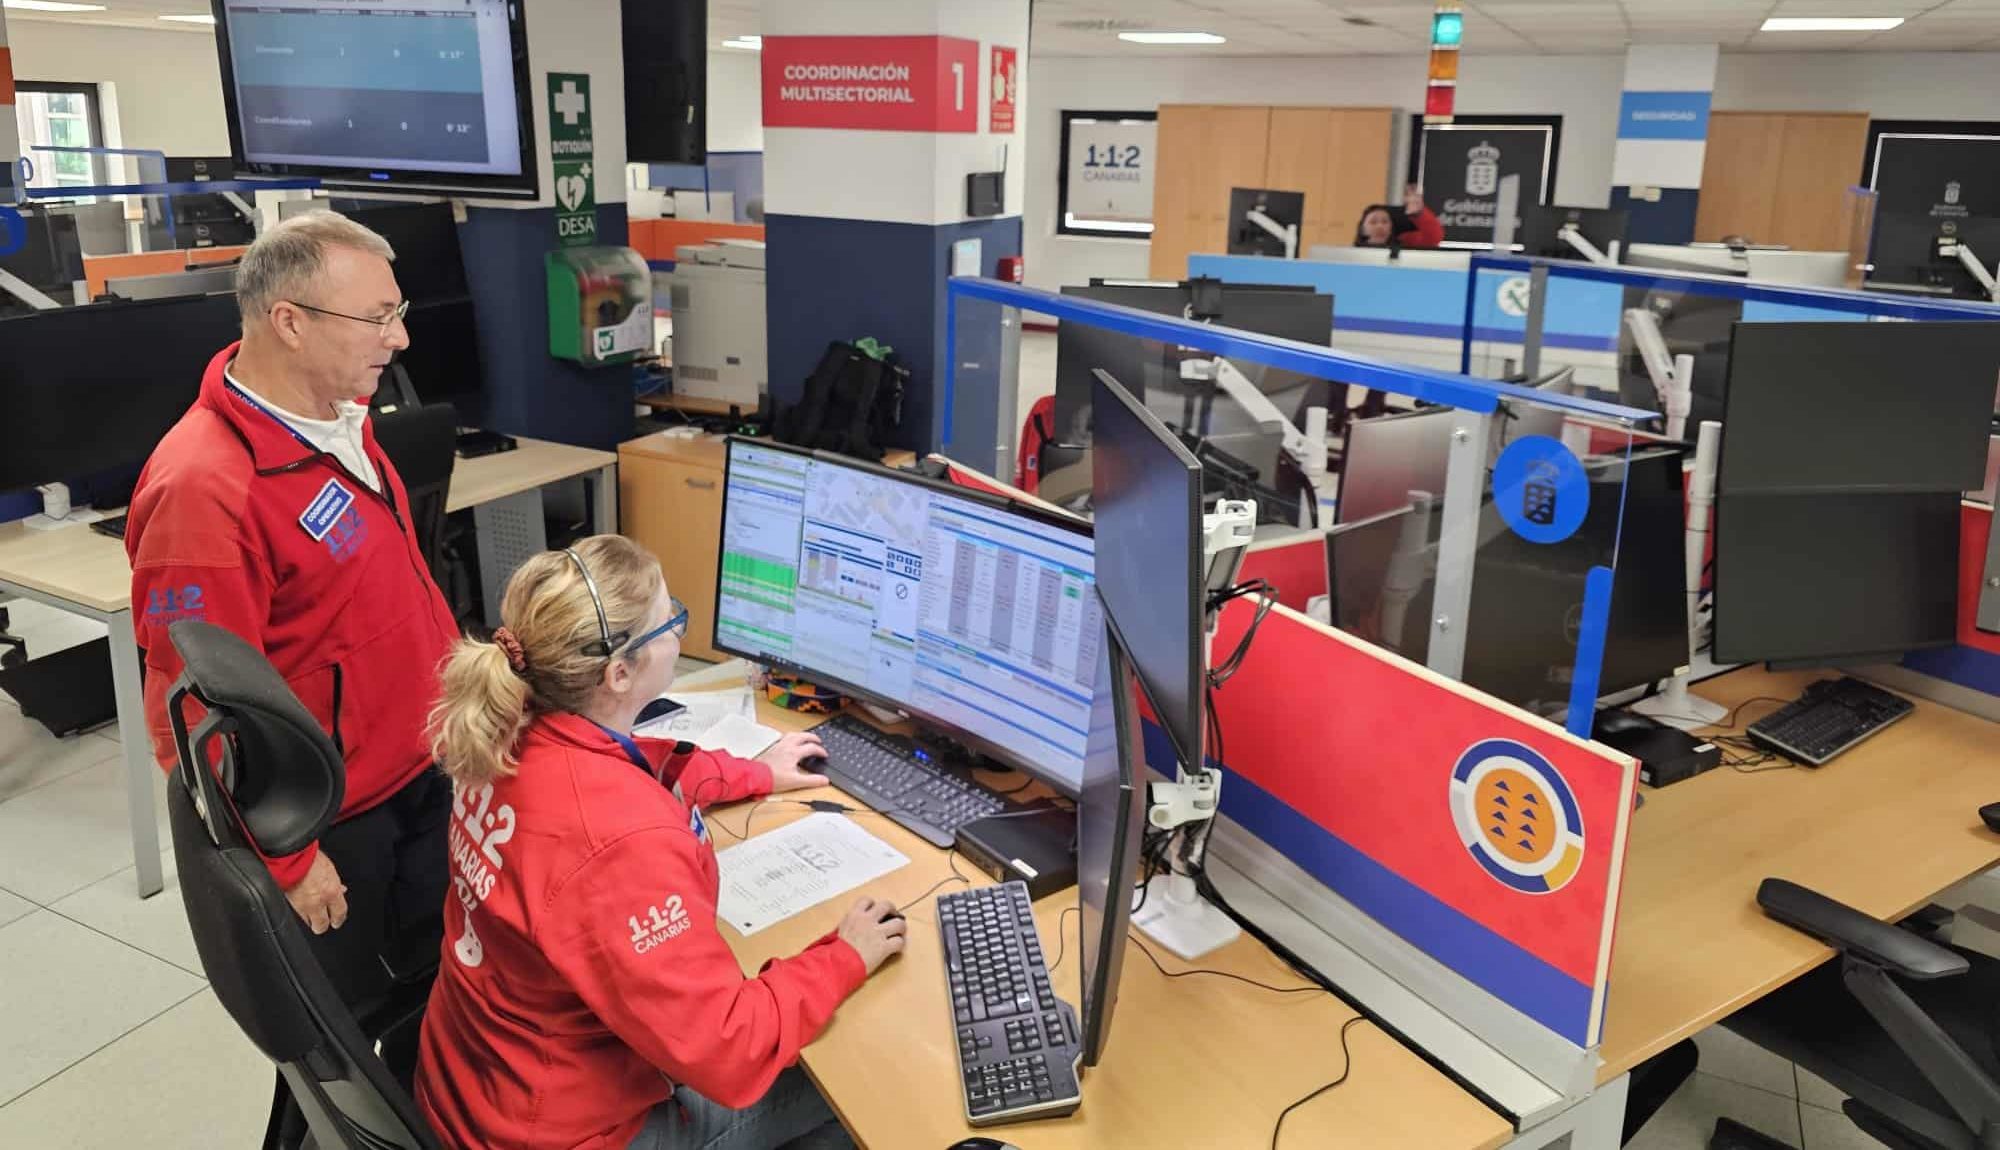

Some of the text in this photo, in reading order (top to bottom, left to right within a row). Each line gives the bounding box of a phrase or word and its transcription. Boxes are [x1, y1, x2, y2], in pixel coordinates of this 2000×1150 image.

[783, 62, 910, 81] COORDINACIÓN
[780, 86, 915, 103] MULTISECTORIAL
[951, 62, 964, 112] 1
[558, 216, 594, 236] DESA
[633, 916, 691, 955] CANARIAS
